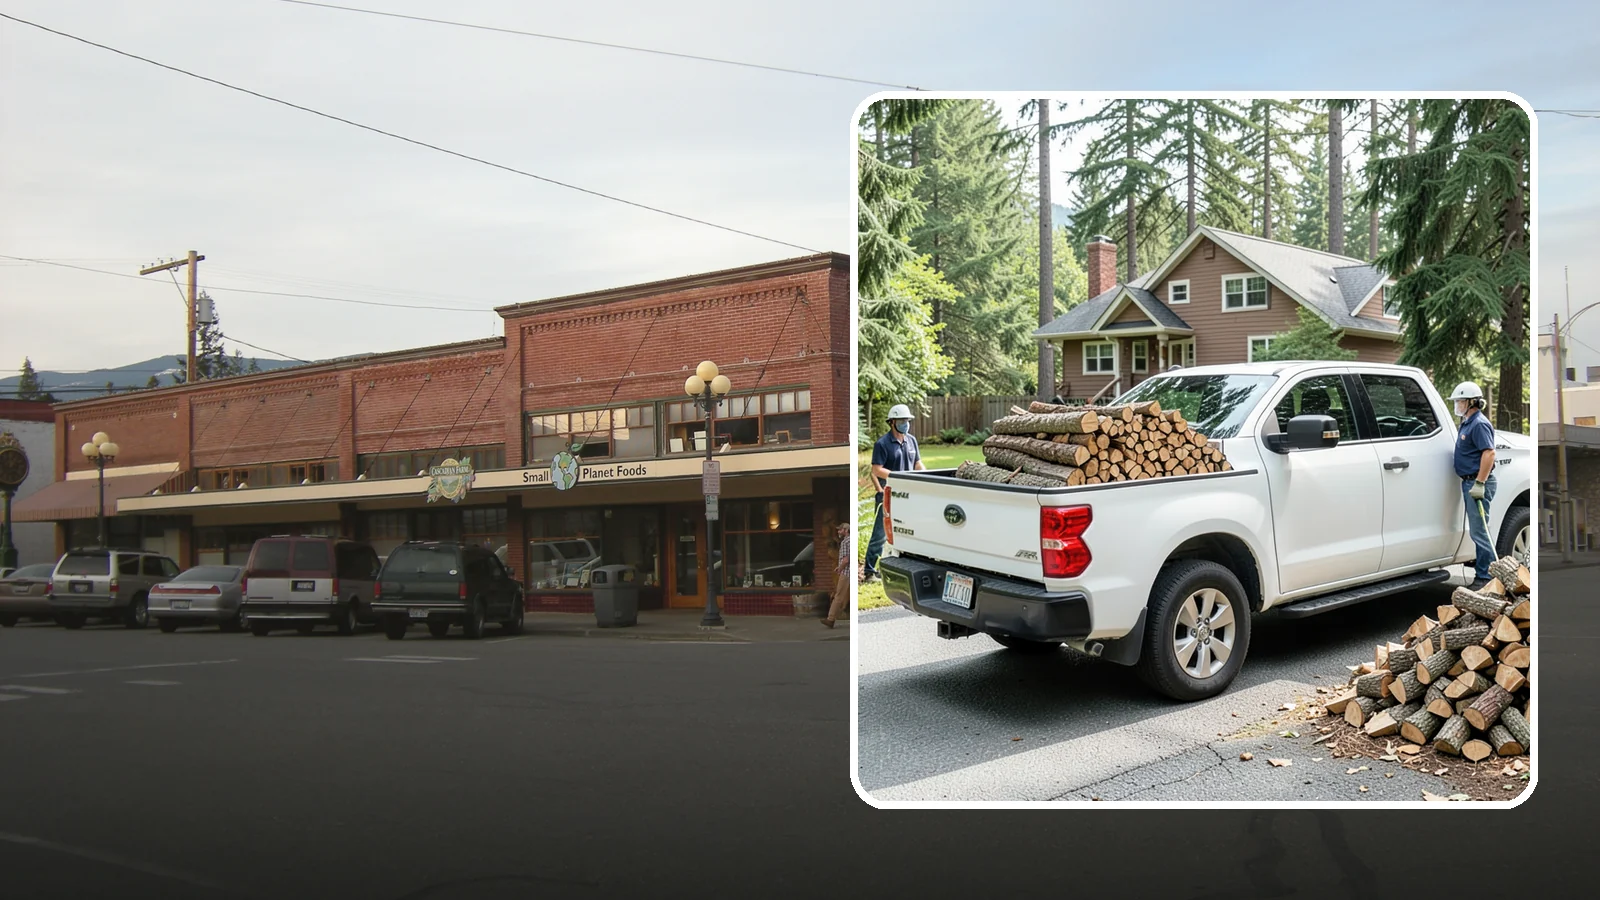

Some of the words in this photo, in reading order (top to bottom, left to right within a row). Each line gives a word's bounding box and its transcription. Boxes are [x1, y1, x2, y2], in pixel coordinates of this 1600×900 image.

[523, 471, 549, 483] Small
[582, 467, 614, 479] Planet
[616, 464, 647, 477] Foods
